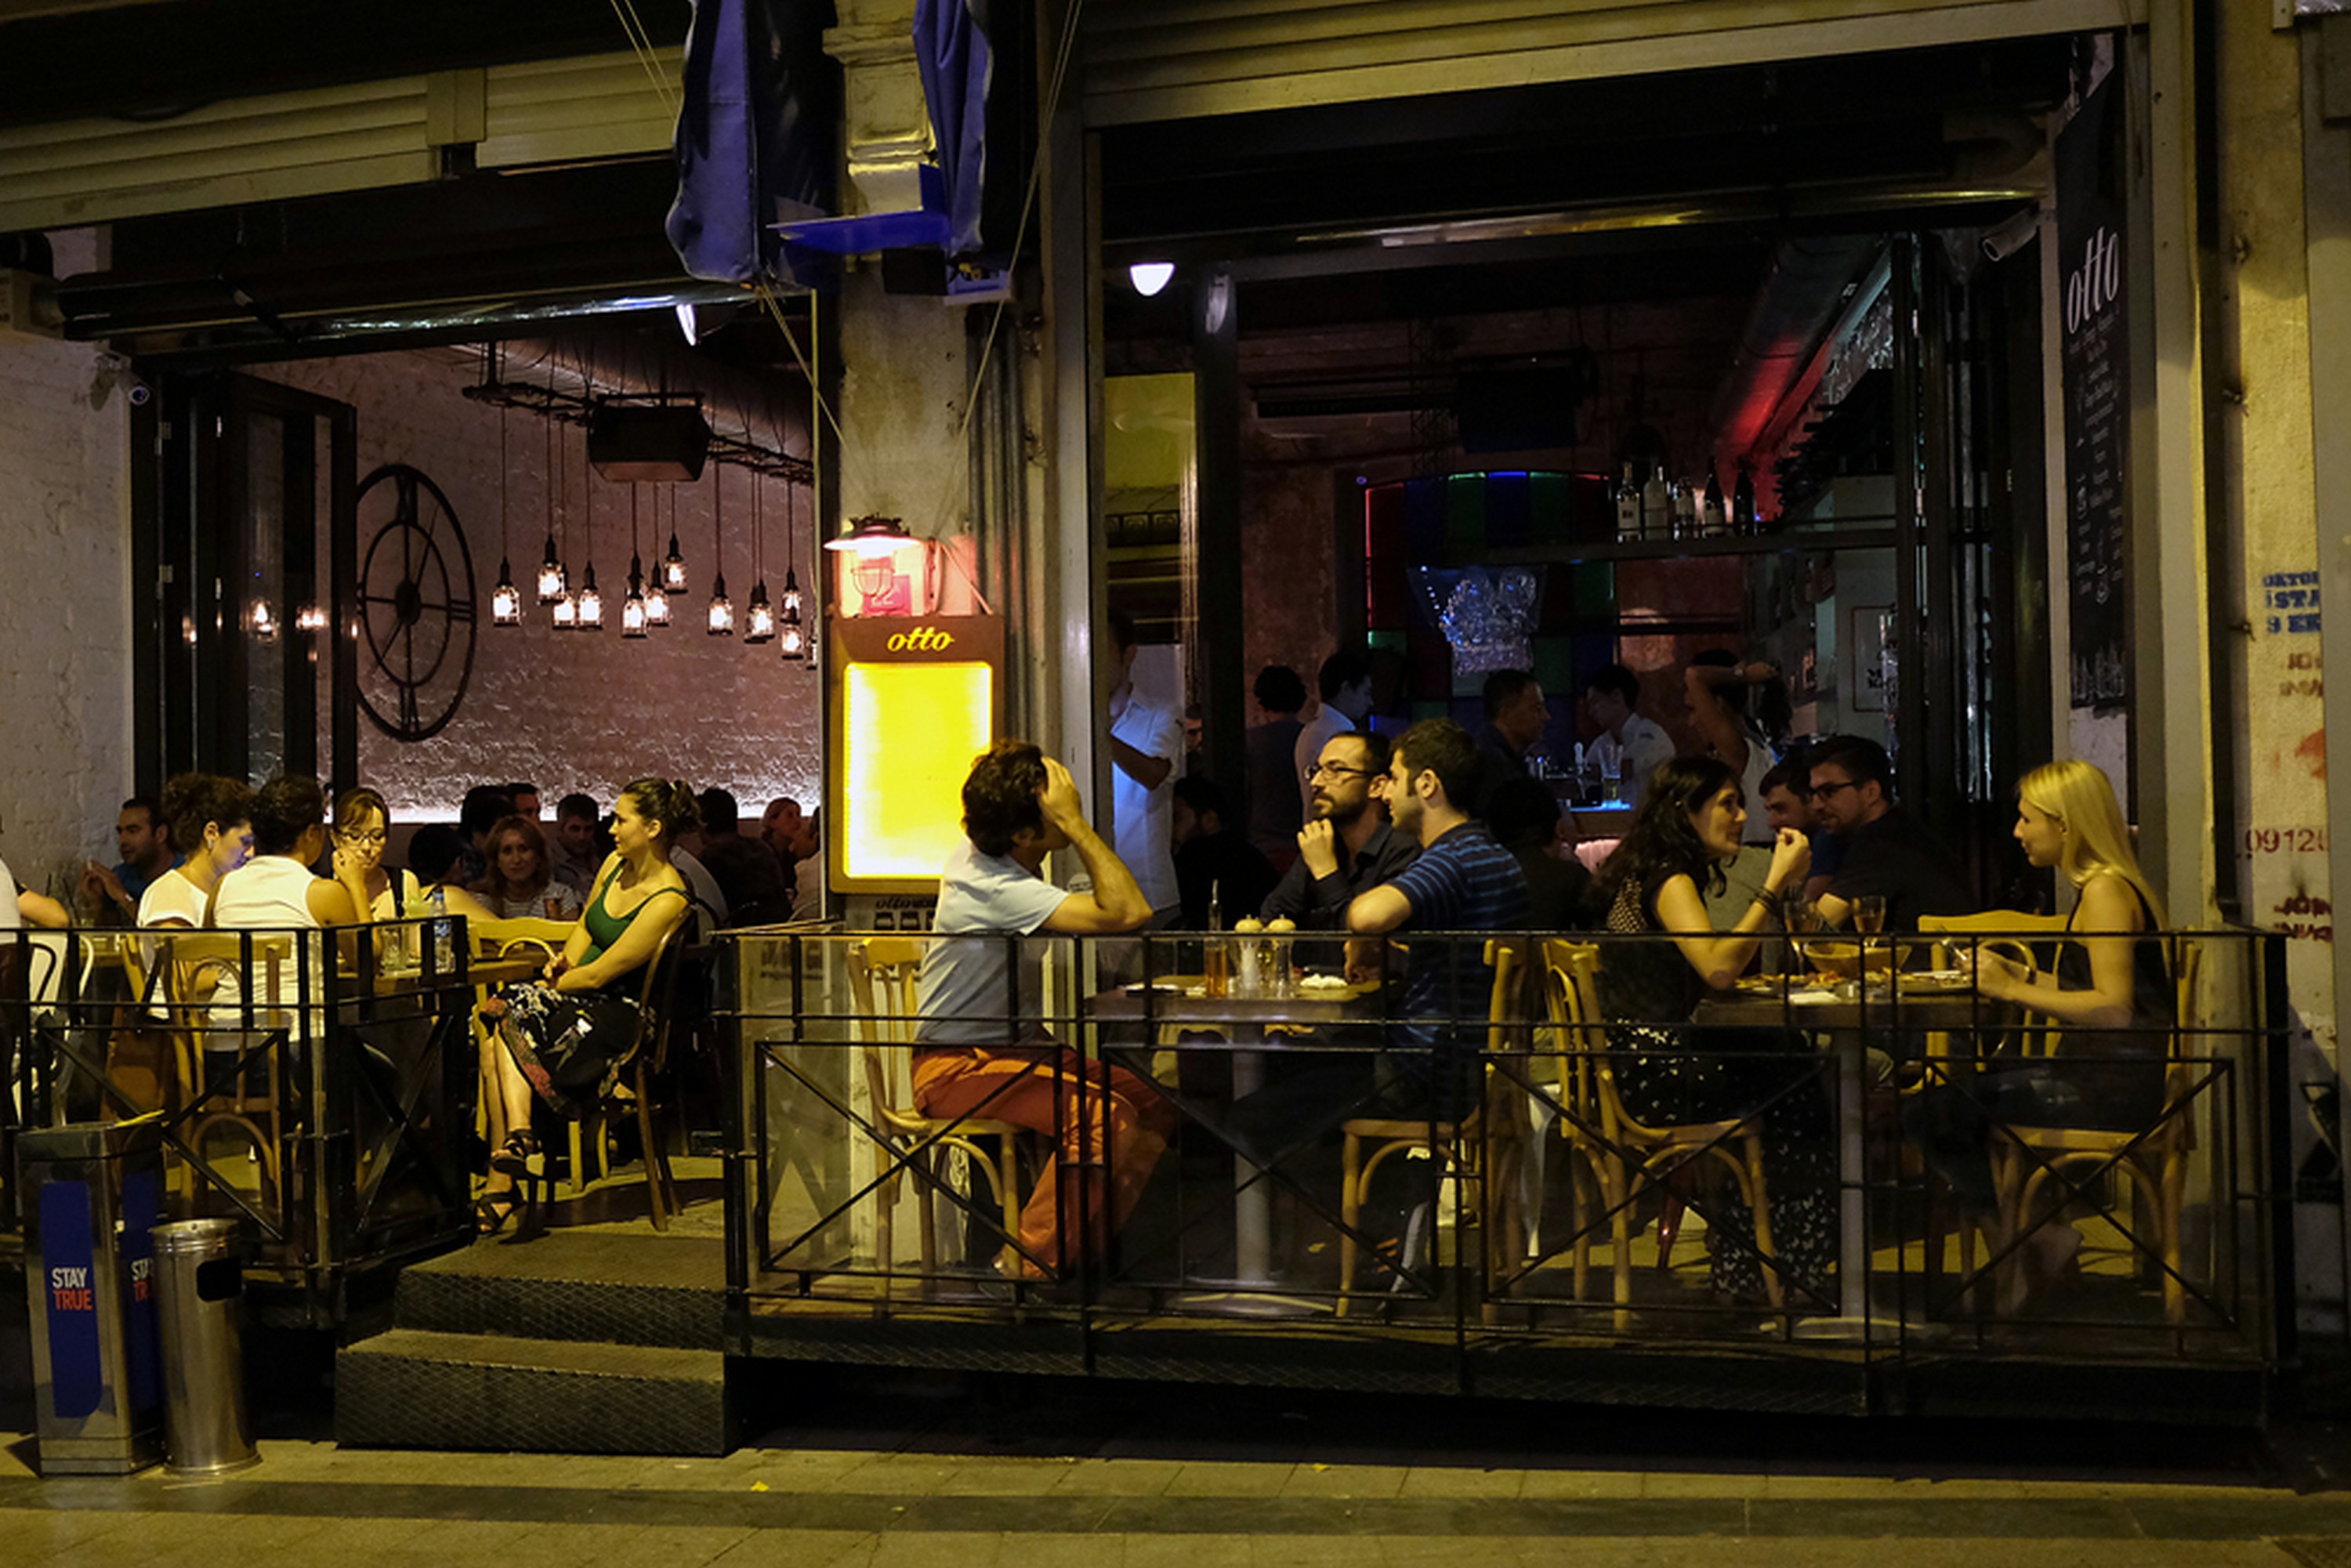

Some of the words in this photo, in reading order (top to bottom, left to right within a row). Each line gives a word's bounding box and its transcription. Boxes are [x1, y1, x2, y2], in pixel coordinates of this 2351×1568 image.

[2067, 226, 2119, 335] otto
[887, 627, 955, 652] otto
[51, 1266, 88, 1288] STAY
[53, 1289, 93, 1311] TRUE
